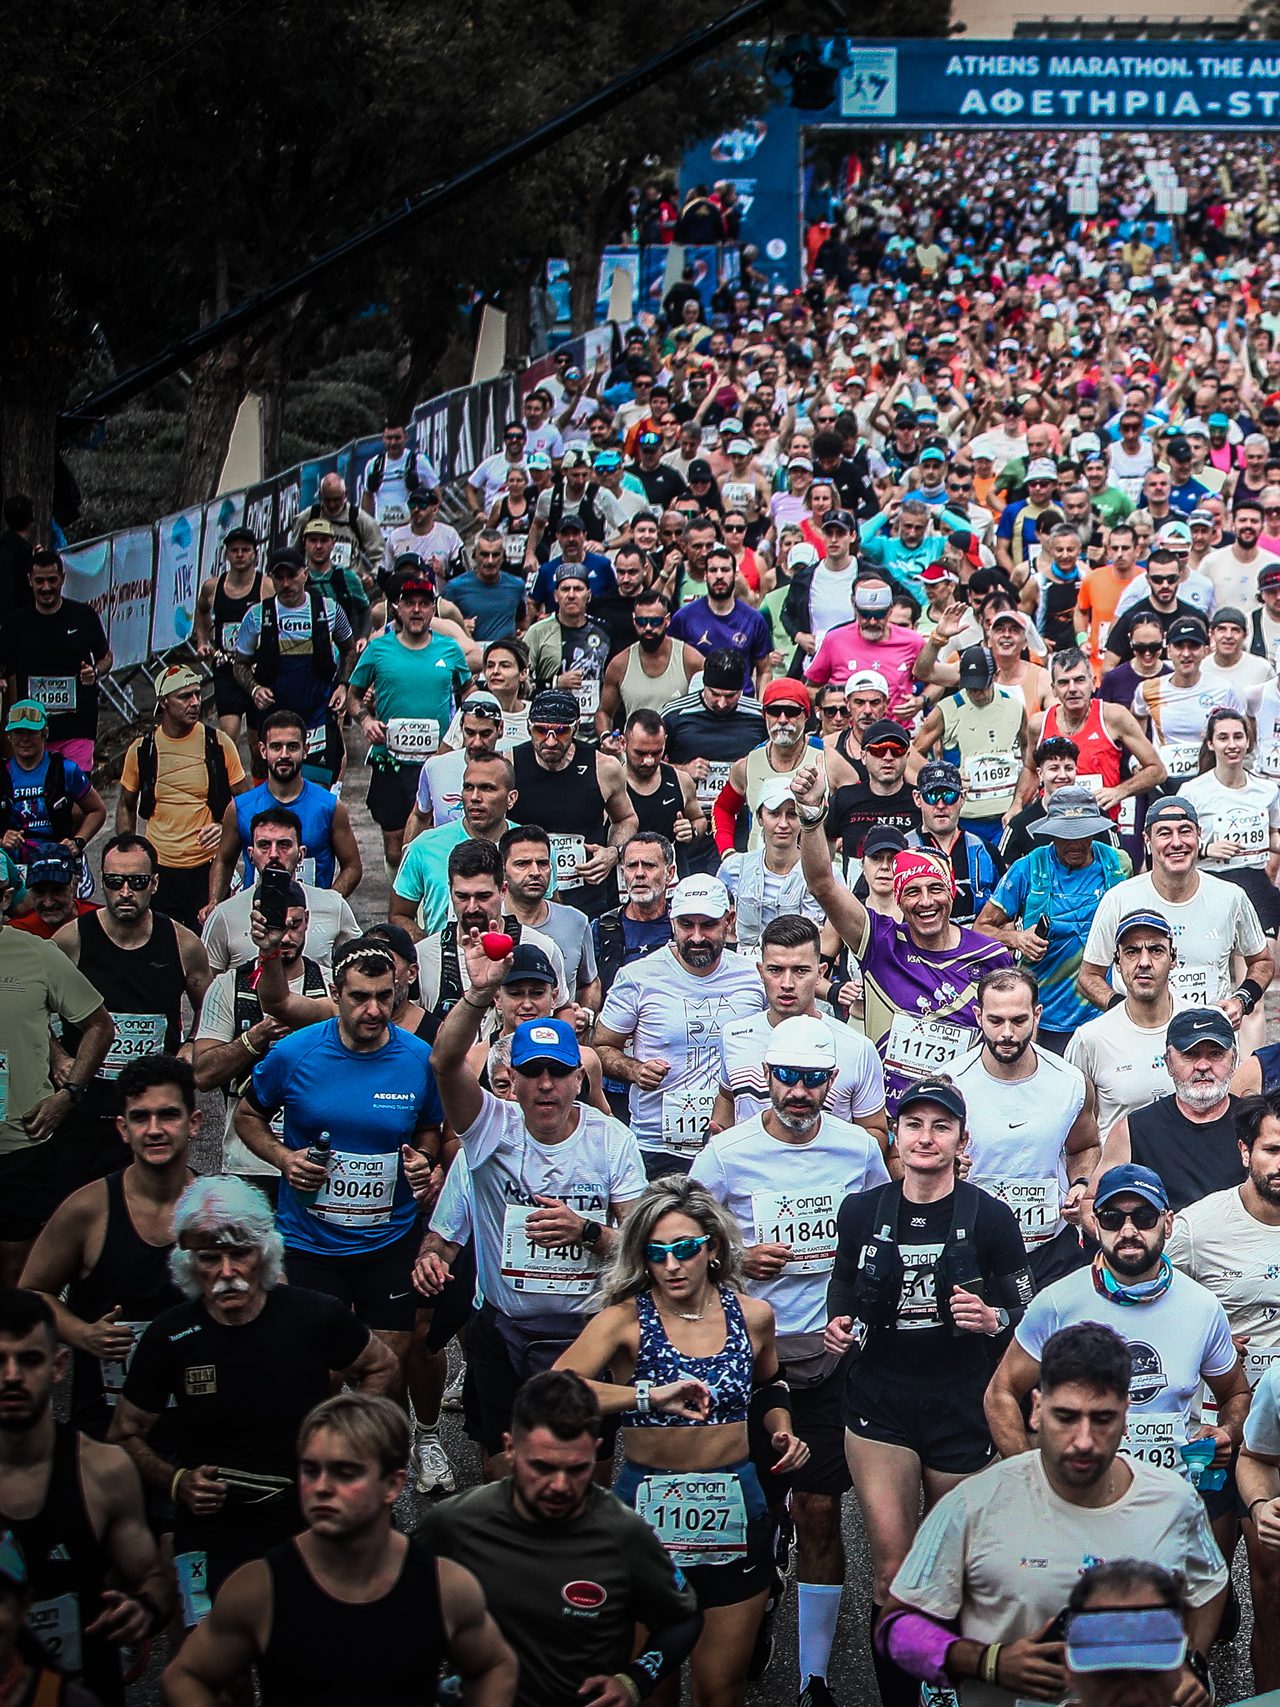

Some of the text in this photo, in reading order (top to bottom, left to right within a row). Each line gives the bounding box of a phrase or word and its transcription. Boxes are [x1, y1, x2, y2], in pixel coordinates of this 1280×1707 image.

[945, 56, 1039, 77] ATHENS
[1049, 56, 1193, 77] MARATHON.
[1197, 57, 1242, 78] THE
[394, 734, 432, 747] 12206
[975, 767, 1011, 782] 11692
[1224, 829, 1265, 847] 12189
[556, 853, 577, 868] 63
[901, 1037, 957, 1063] 11731
[373, 1093, 410, 1101] AEGEAN
[572, 1182, 603, 1194] team
[770, 1218, 838, 1244] 11840
[652, 1507, 731, 1533] 11027
